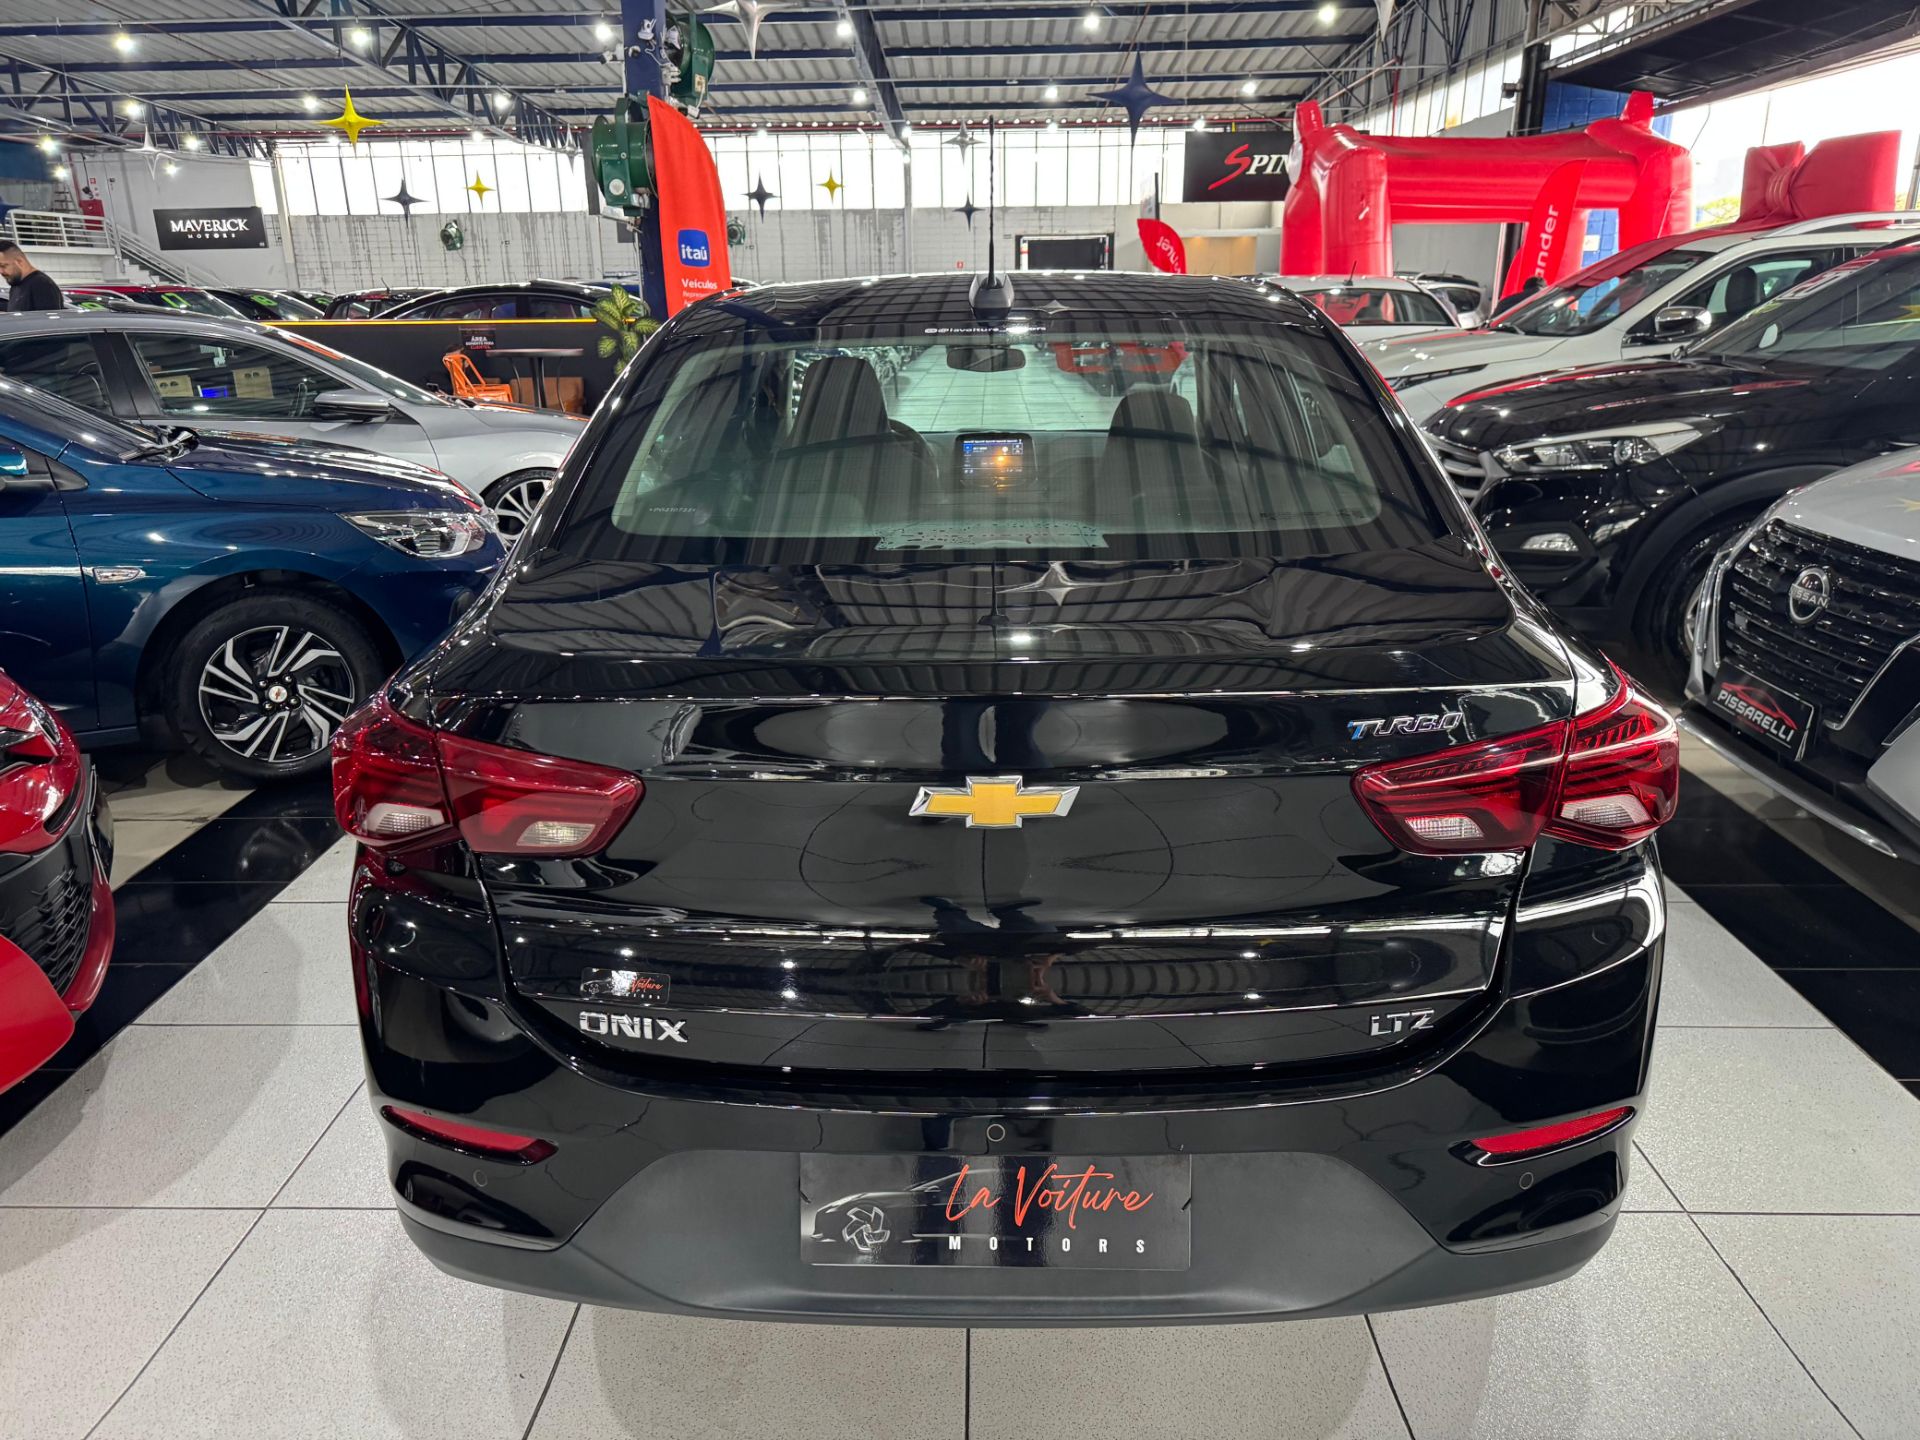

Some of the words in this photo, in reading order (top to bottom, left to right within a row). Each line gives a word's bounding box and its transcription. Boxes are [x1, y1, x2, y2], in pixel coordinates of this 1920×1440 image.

[170, 219, 250, 233] MAVERICK
[681, 244, 708, 261] itaú
[1347, 713, 1462, 740] TURBO
[1717, 689, 1795, 742] PISSARELLI
[580, 1011, 688, 1043] ONIX
[1371, 1010, 1434, 1035] LTZ
[945, 1163, 1001, 1222] La
[1014, 1163, 1154, 1230] Voiture
[948, 1235, 1145, 1254] MOTORS
